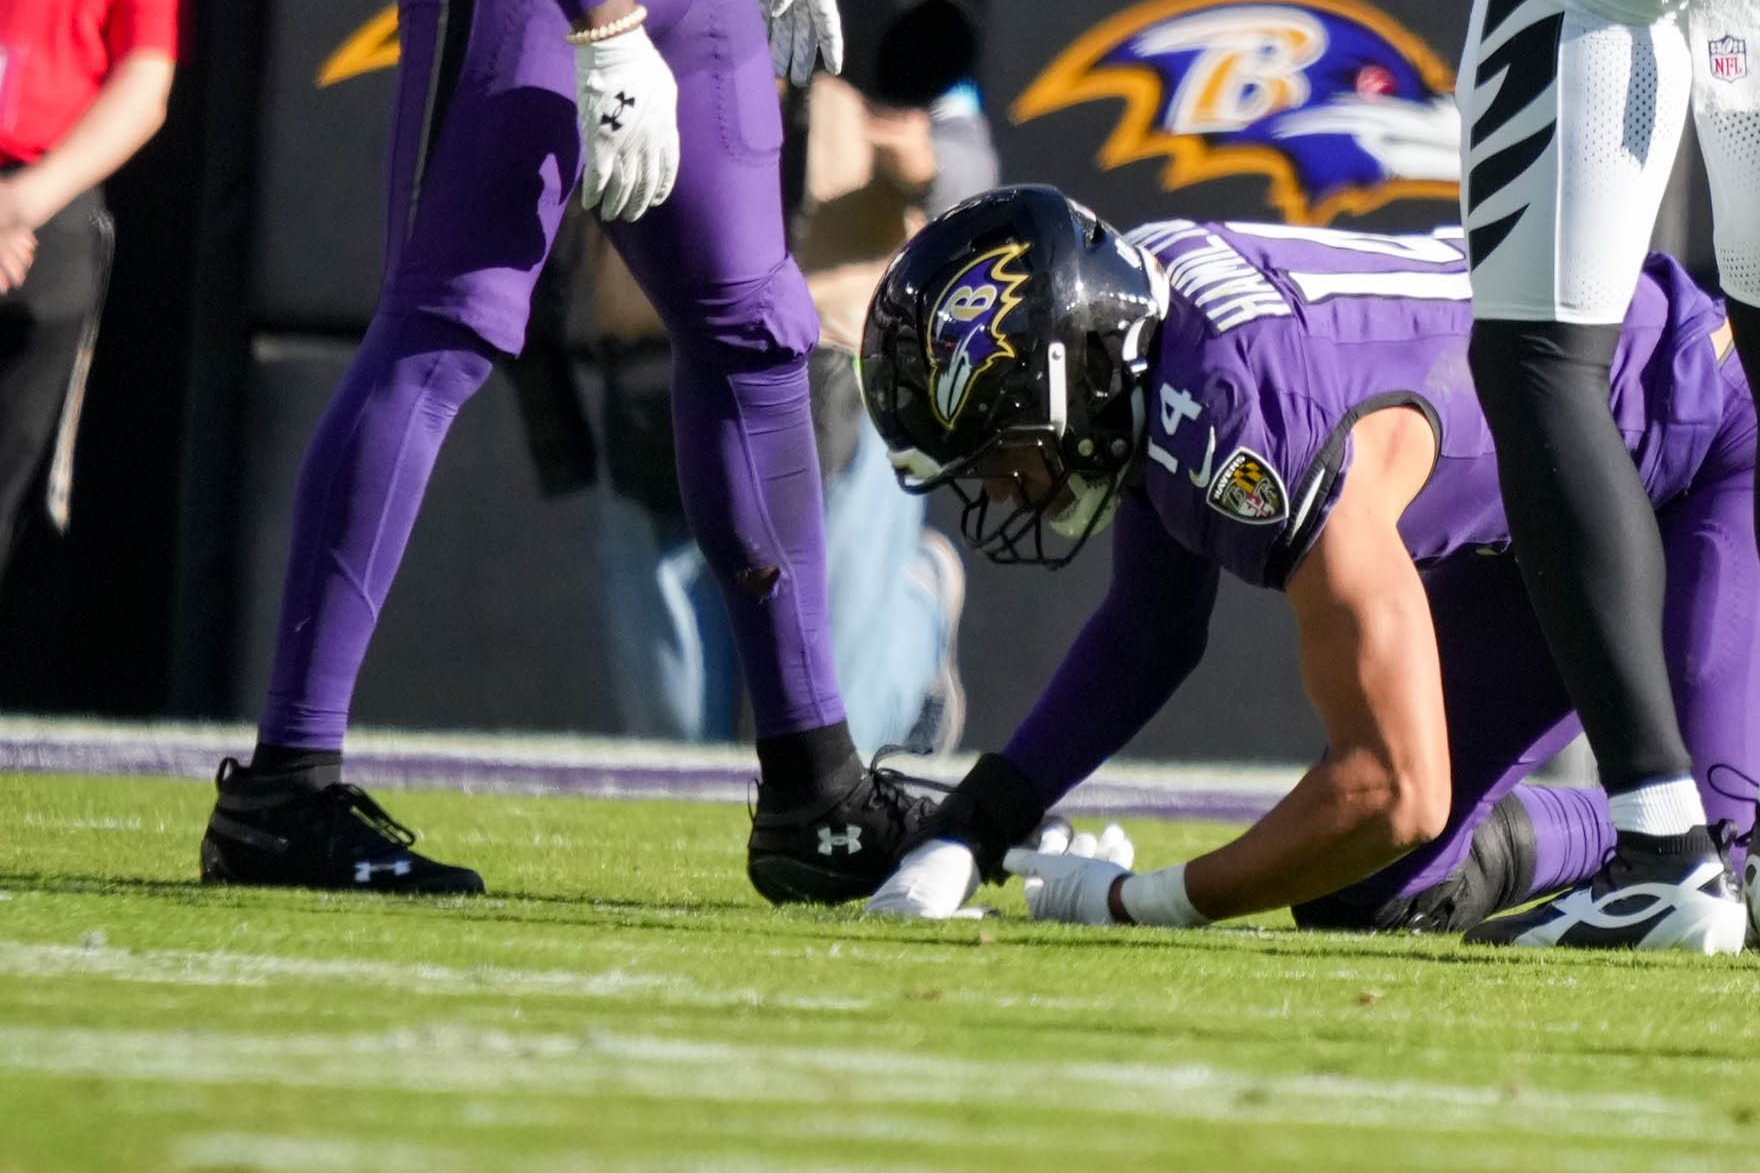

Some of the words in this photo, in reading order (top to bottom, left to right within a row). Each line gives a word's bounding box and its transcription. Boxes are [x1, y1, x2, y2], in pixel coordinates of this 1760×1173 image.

[1714, 56, 1743, 76] NFL
[1149, 381, 1204, 475] 14
[1213, 454, 1246, 500] RAVENS
